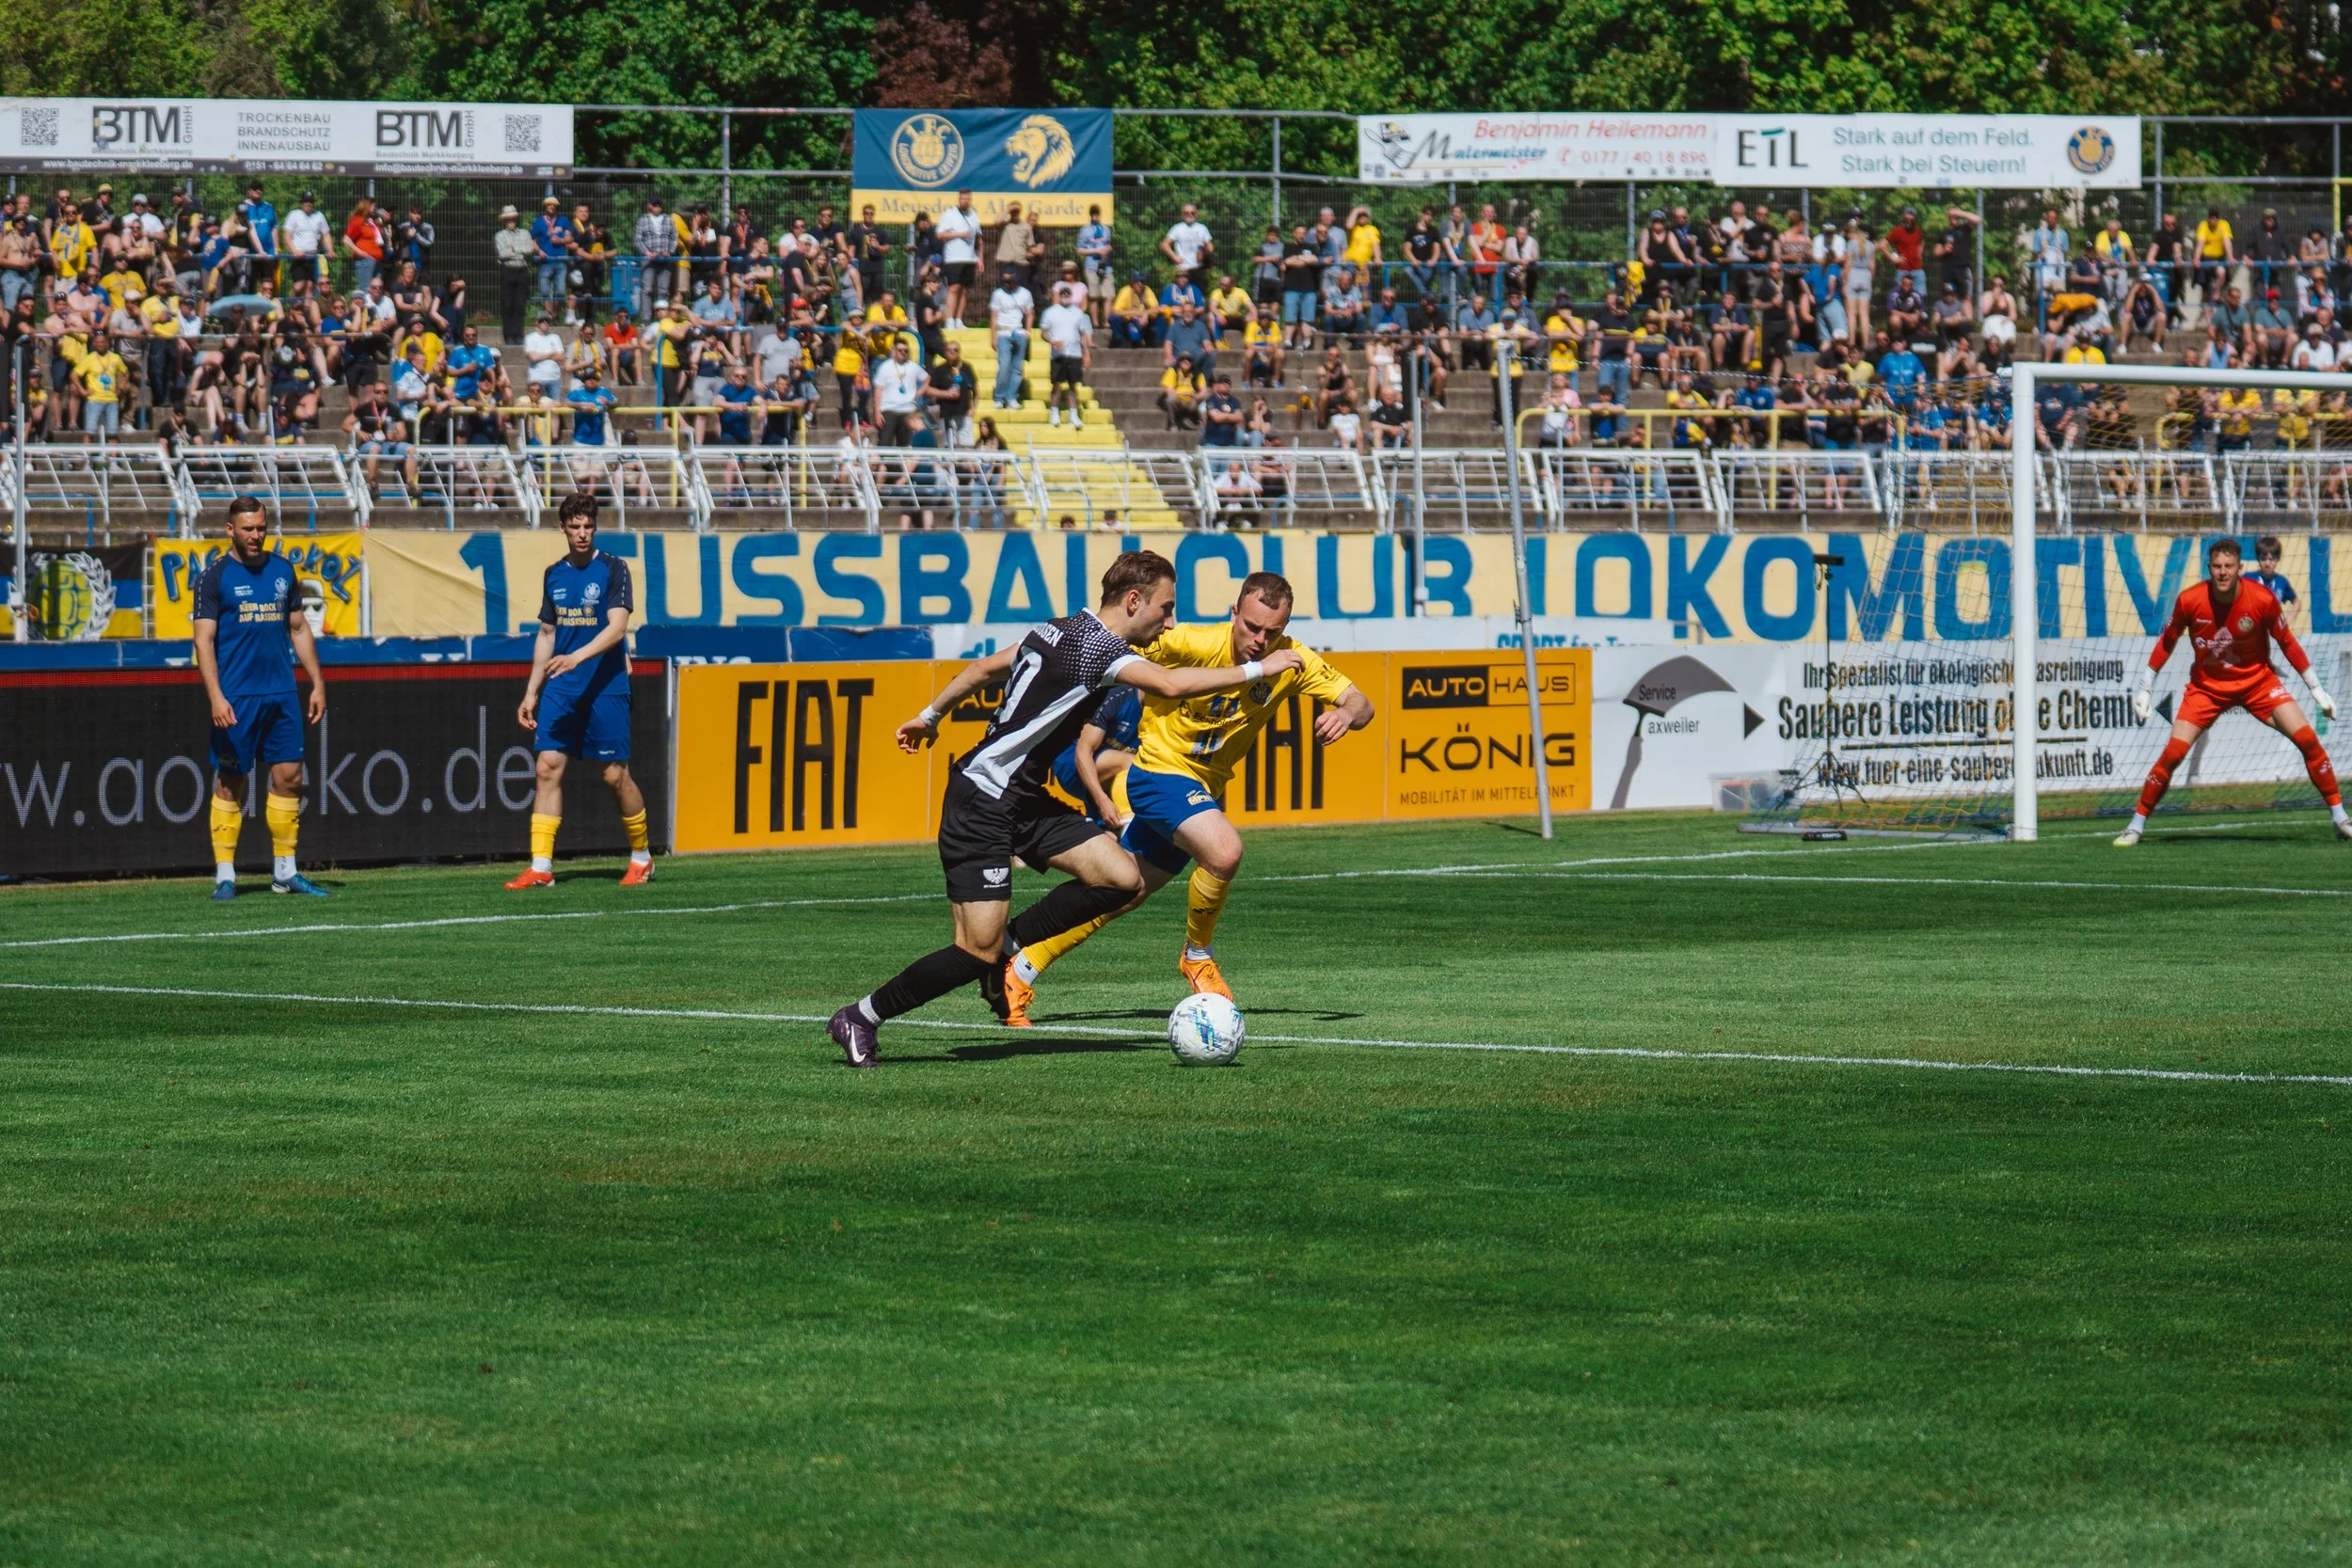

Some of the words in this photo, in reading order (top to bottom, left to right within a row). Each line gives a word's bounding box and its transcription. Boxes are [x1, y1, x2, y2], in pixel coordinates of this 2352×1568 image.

[93, 105, 181, 143] BTM
[238, 112, 330, 123] TROCKENBAU
[376, 109, 462, 148] BTM
[238, 126, 331, 137] BRANDSCHUTZ
[1475, 119, 1580, 140] Benjamin
[1835, 127, 1885, 145] Stark
[1893, 127, 1924, 145] auf
[1931, 127, 1978, 145] dem
[1984, 127, 2034, 146] Feld.
[238, 140, 330, 151] INNENAUSBAU
[1738, 127, 1809, 167] ETL
[1842, 154, 1895, 172] Stark
[1900, 154, 1932, 172] bei
[1938, 154, 2026, 172] Steuern!
[881, 198, 978, 215] Meusdos
[1026, 199, 1085, 215] Garde
[1525, 532, 2258, 641] LOKOMOTIV
[1804, 662, 1824, 688] Ihr
[1905, 660, 1925, 687] für
[1930, 657, 2014, 687] ökologisch
[2036, 657, 2124, 684] asreinigung
[1407, 675, 1486, 698] AUTO
[1638, 684, 1677, 702] Service
[1648, 717, 1700, 733] axweiler
[1778, 695, 1882, 739] Saubere
[1889, 693, 1989, 738] Leistung
[1994, 690, 2052, 732] oe
[735, 678, 874, 833] FIAT
[1220, 694, 1326, 812] IAT
[1400, 722, 1575, 773] KÖNIG
[1400, 787, 1467, 805] MOBILITÄT
[1472, 789, 1485, 801] IM
